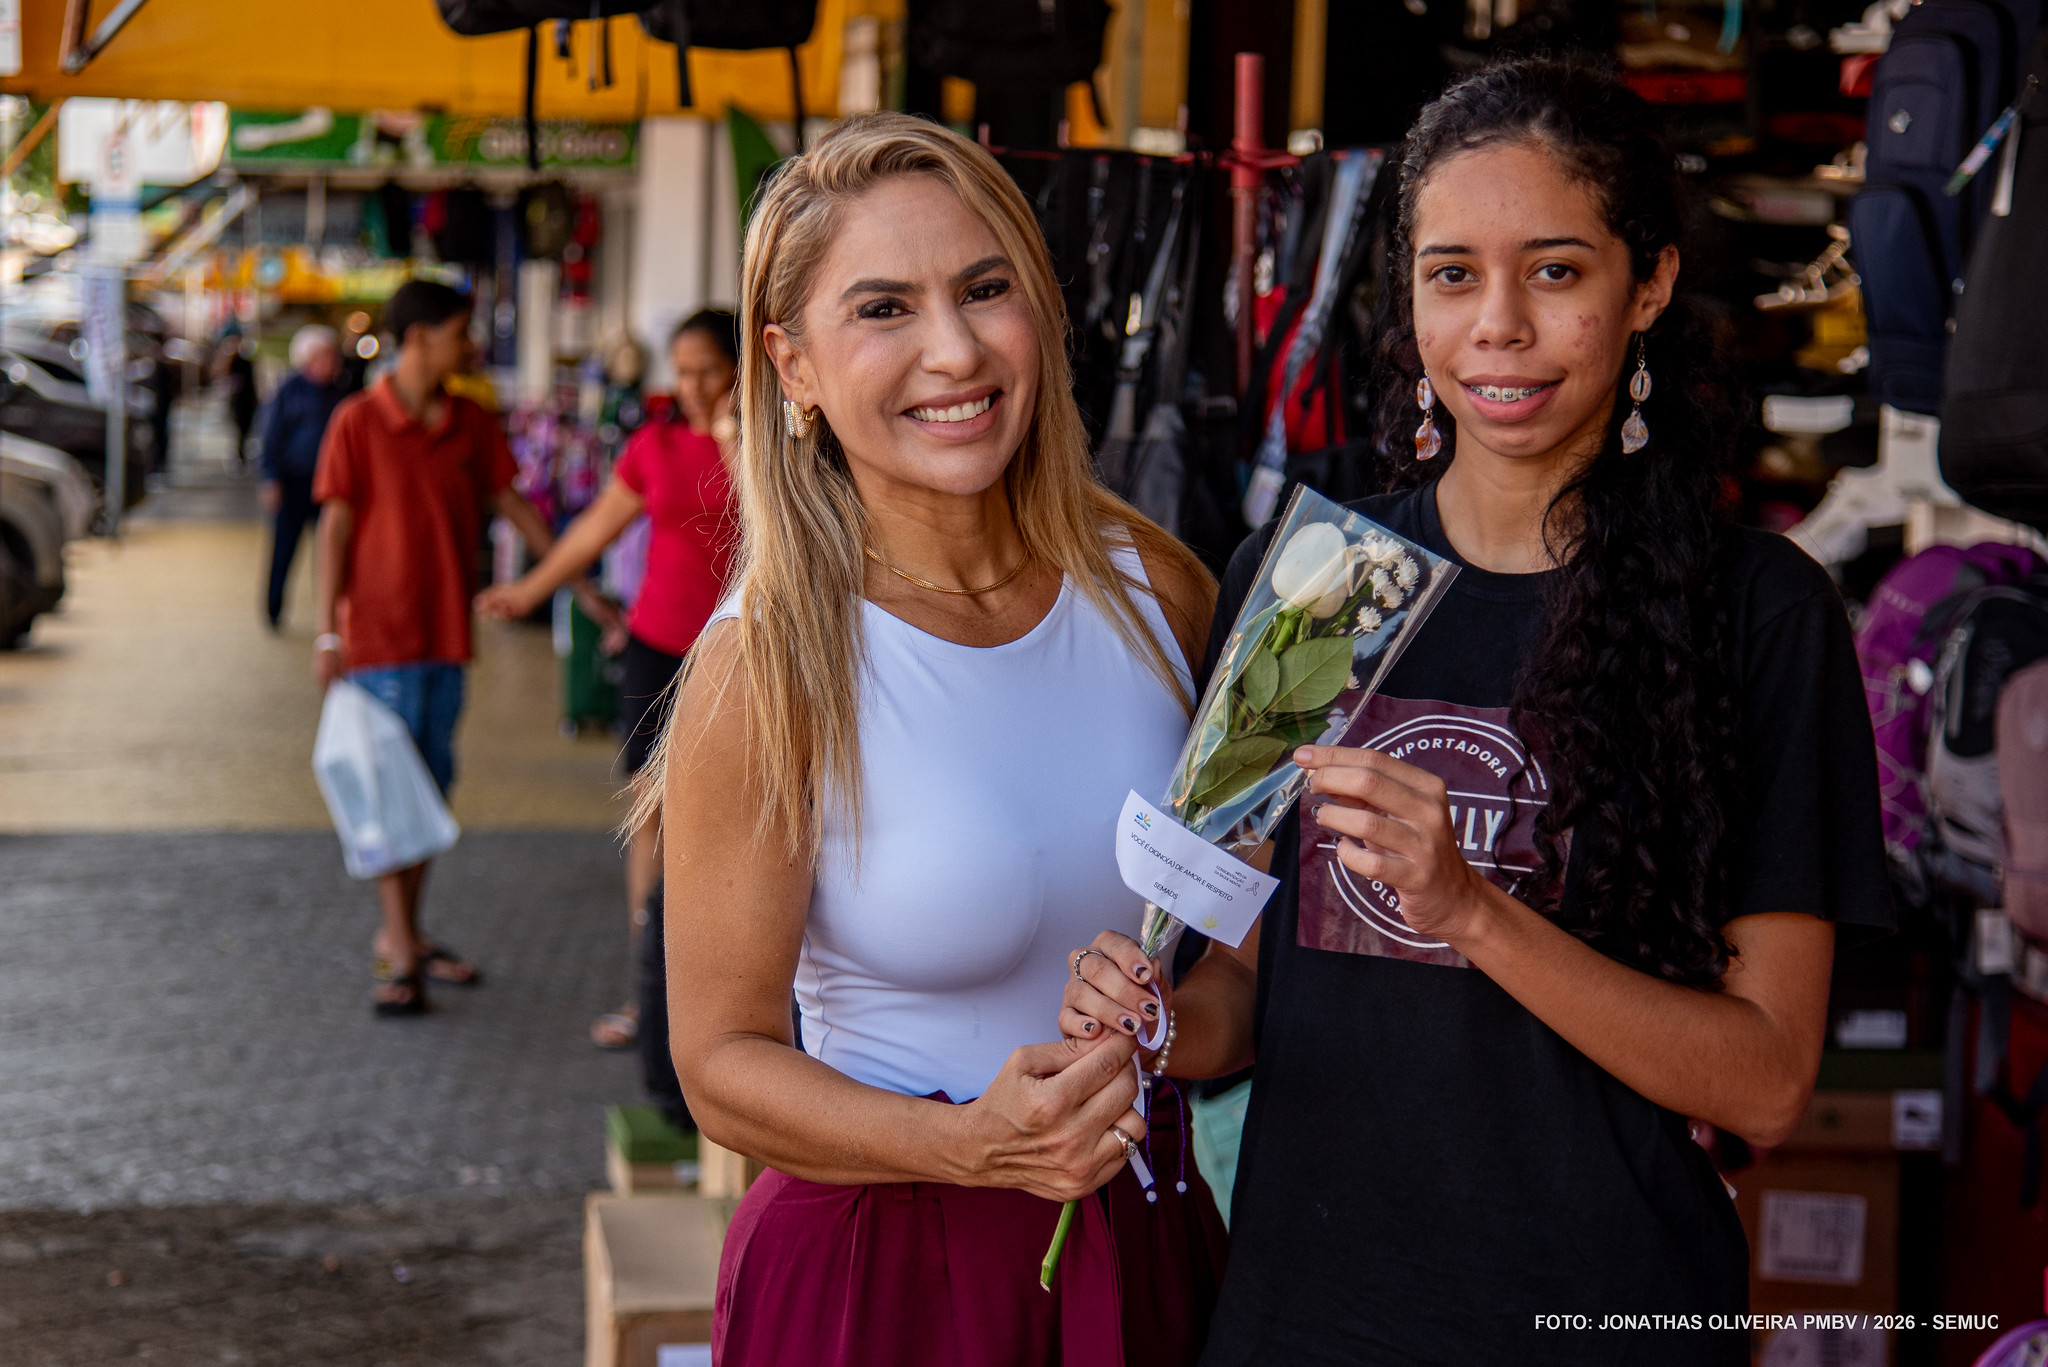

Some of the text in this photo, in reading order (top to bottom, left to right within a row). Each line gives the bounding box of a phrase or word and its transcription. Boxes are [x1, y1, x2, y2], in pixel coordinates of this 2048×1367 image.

[1389, 738, 1508, 779] MPORTADORA
[1131, 832, 1146, 848] VOCÊ
[1144, 843, 1150, 851] É
[1148, 846, 1176, 868] DIGNO(A)
[1174, 863, 1185, 873] DE
[1183, 869, 1203, 884] AMOR
[1205, 882, 1234, 902] RESPEITO
[1153, 881, 1179, 900] SEMADS
